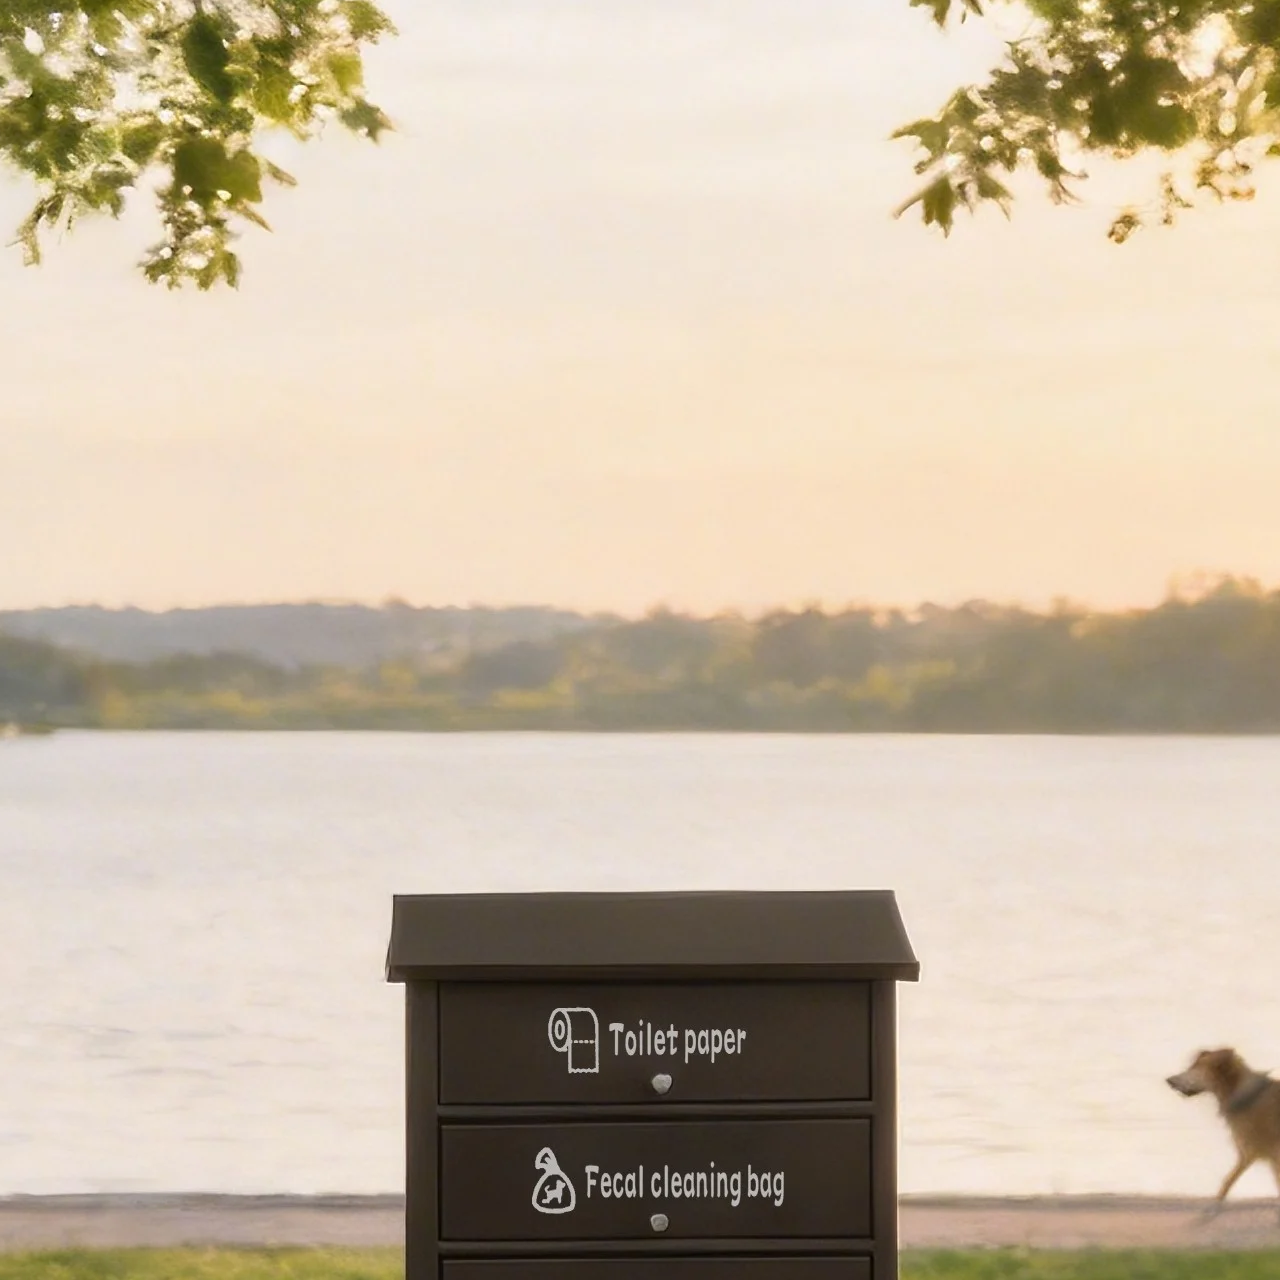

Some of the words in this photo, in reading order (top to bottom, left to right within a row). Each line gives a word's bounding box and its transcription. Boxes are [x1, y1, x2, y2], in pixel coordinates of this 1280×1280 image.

[609, 1019, 679, 1056] Toilet
[685, 1029, 747, 1064] paper
[585, 1164, 644, 1199] Fecal
[651, 1161, 742, 1207] cleaning
[748, 1163, 785, 1207] bag
